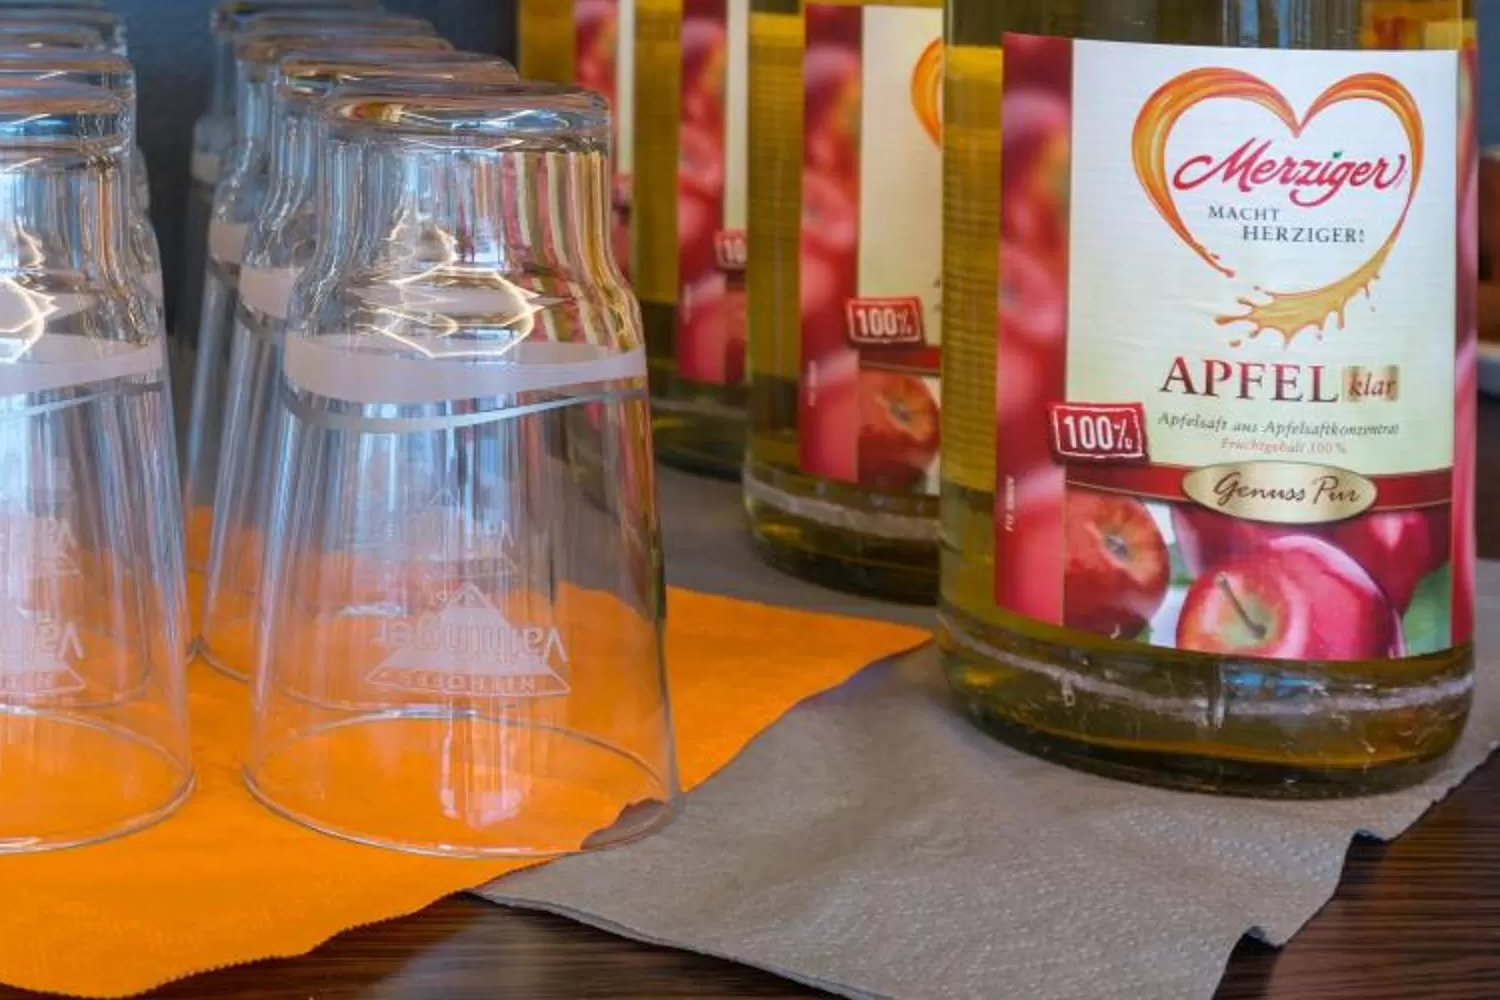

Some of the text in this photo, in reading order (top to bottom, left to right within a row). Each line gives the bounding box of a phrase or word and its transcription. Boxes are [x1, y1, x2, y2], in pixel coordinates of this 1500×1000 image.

[1173, 138, 1407, 207] Merziger
[1208, 205, 1280, 221] MACHT
[1242, 225, 1365, 243] HERZIGER!
[855, 308, 913, 337] 100%
[1159, 356, 1339, 403] APFEL
[1065, 412, 1133, 450] 100%
[1157, 412, 1228, 433] Apfelsaft
[1233, 422, 1258, 433] aus
[1213, 471, 1361, 505] Genuss Pur
